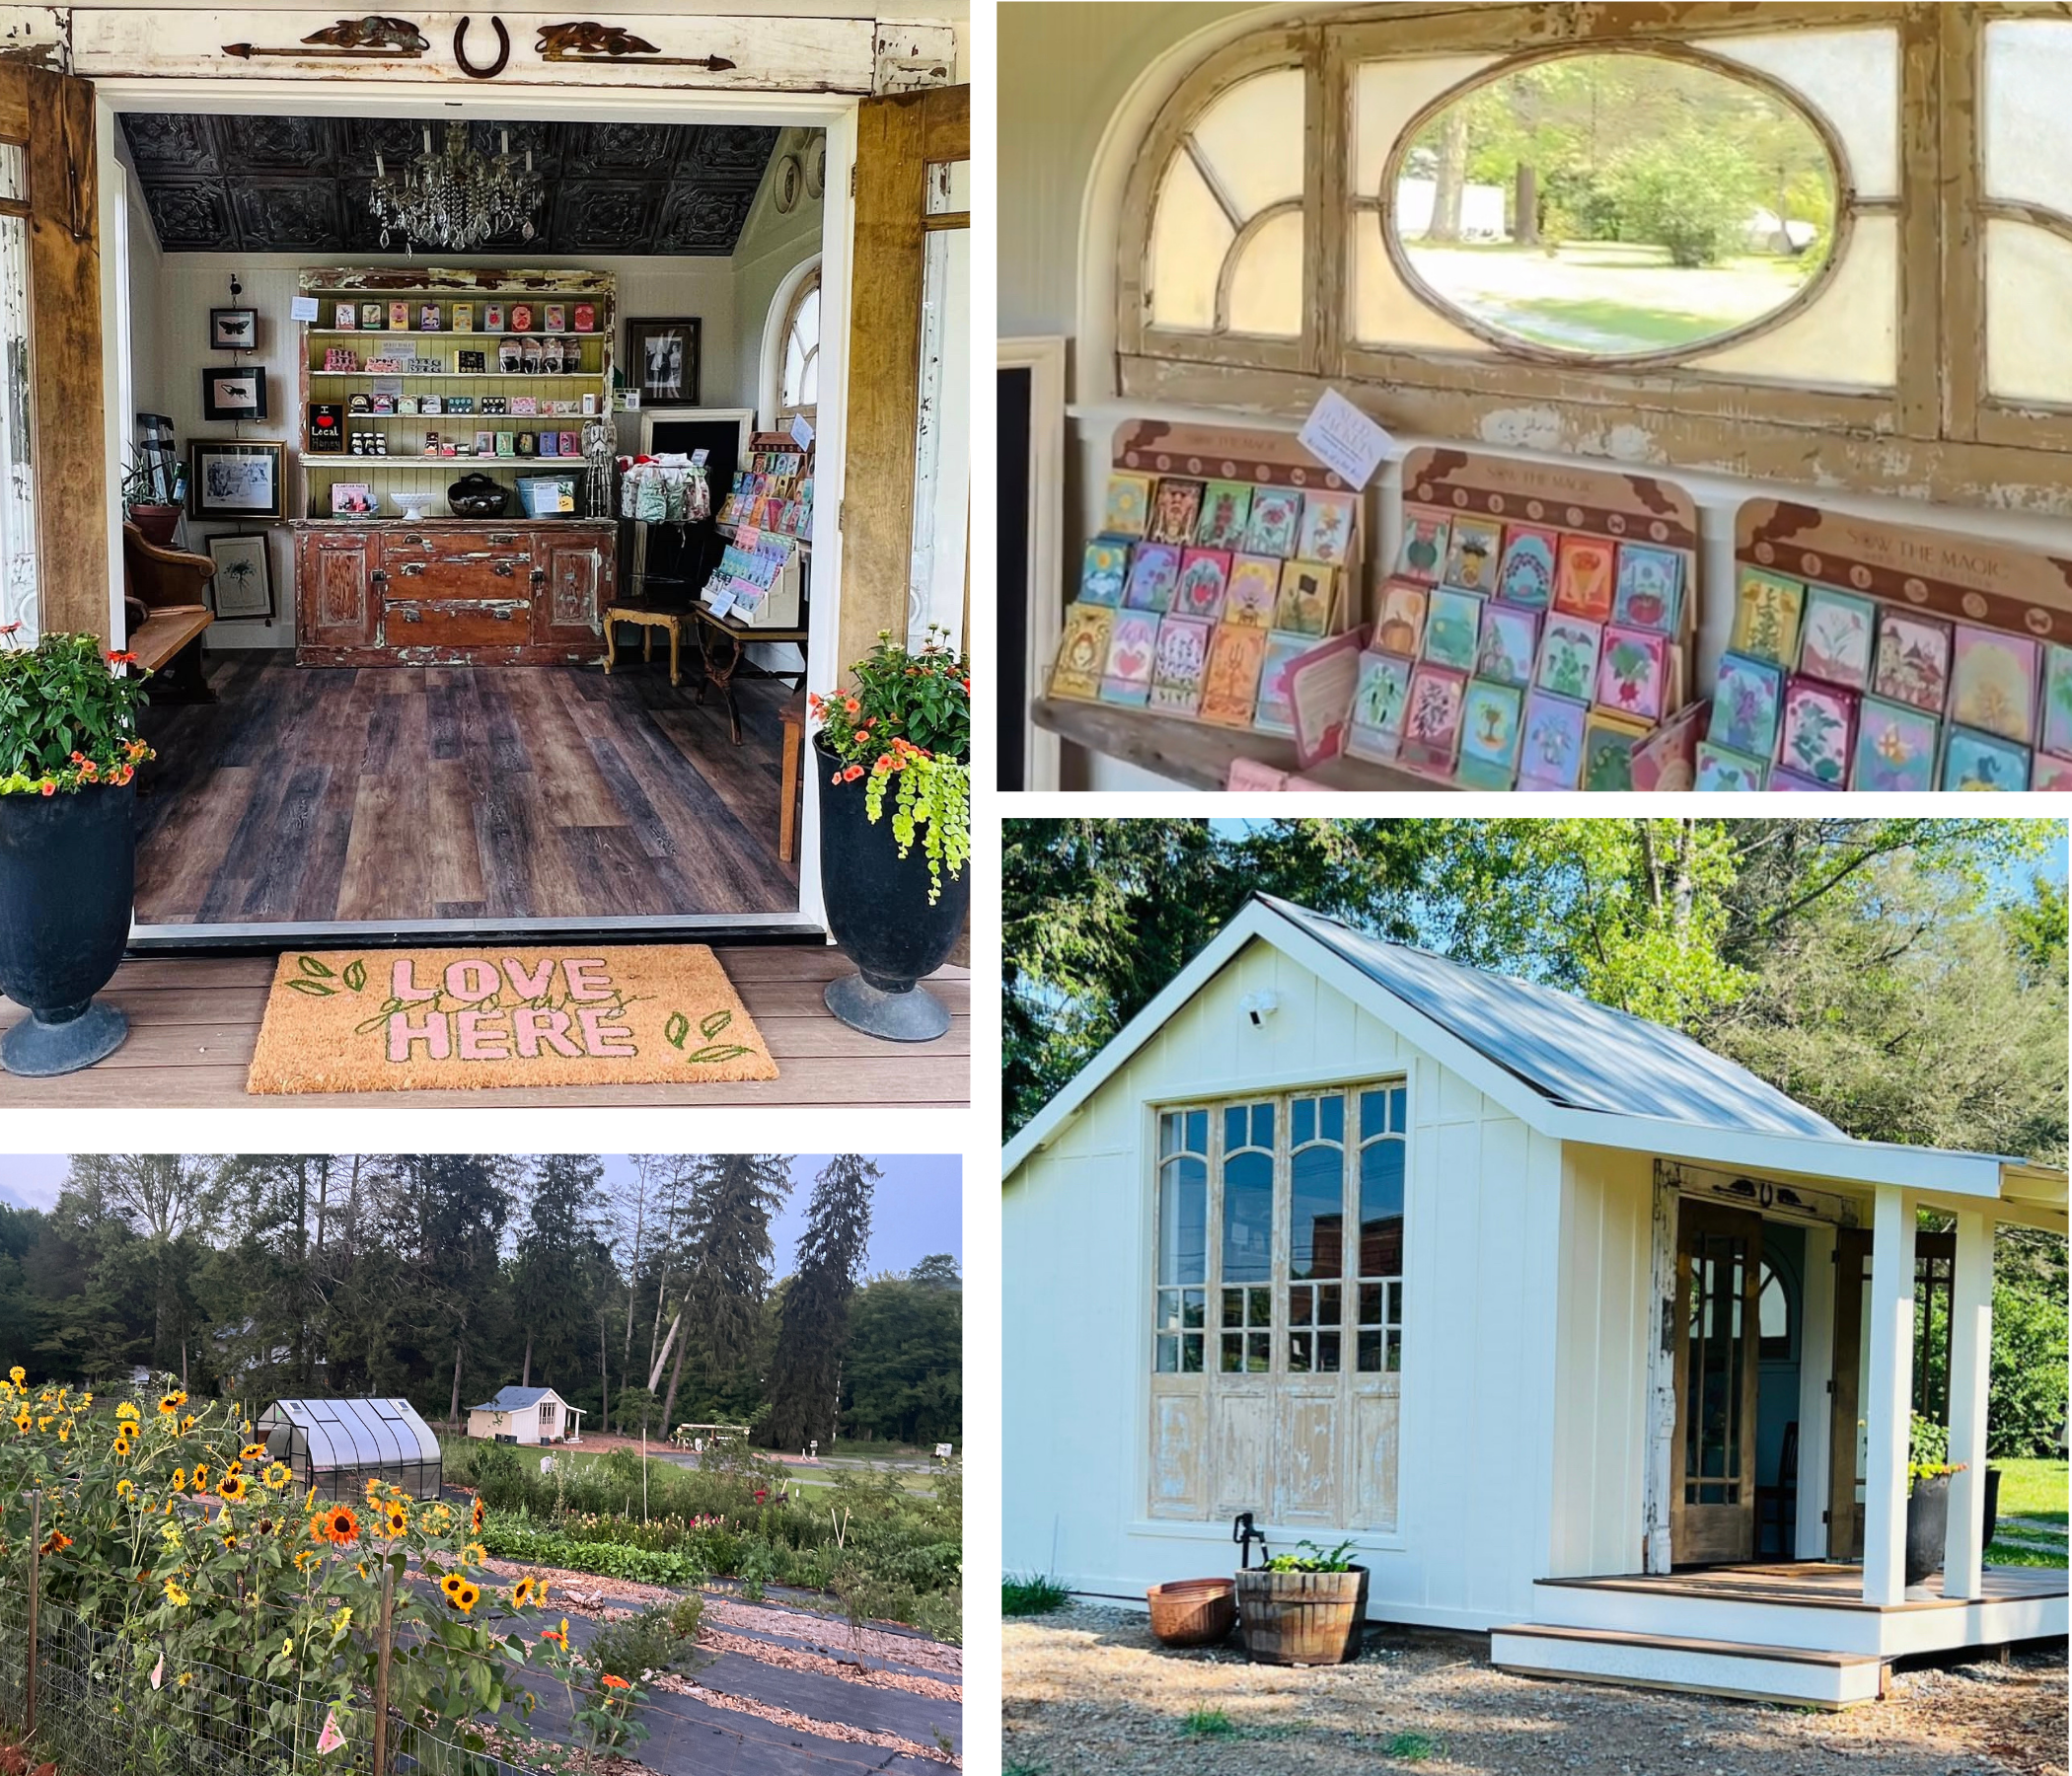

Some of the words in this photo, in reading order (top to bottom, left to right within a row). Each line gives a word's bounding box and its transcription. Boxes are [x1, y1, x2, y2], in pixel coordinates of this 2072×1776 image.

[311, 425, 338, 436] Local
[312, 437, 340, 450] Honey
[1847, 527, 1891, 553] SOW
[1899, 541, 1934, 563] THE
[1941, 549, 2010, 580] MAGIC
[391, 958, 616, 1003] LOVE
[385, 1007, 638, 1063] HERE
